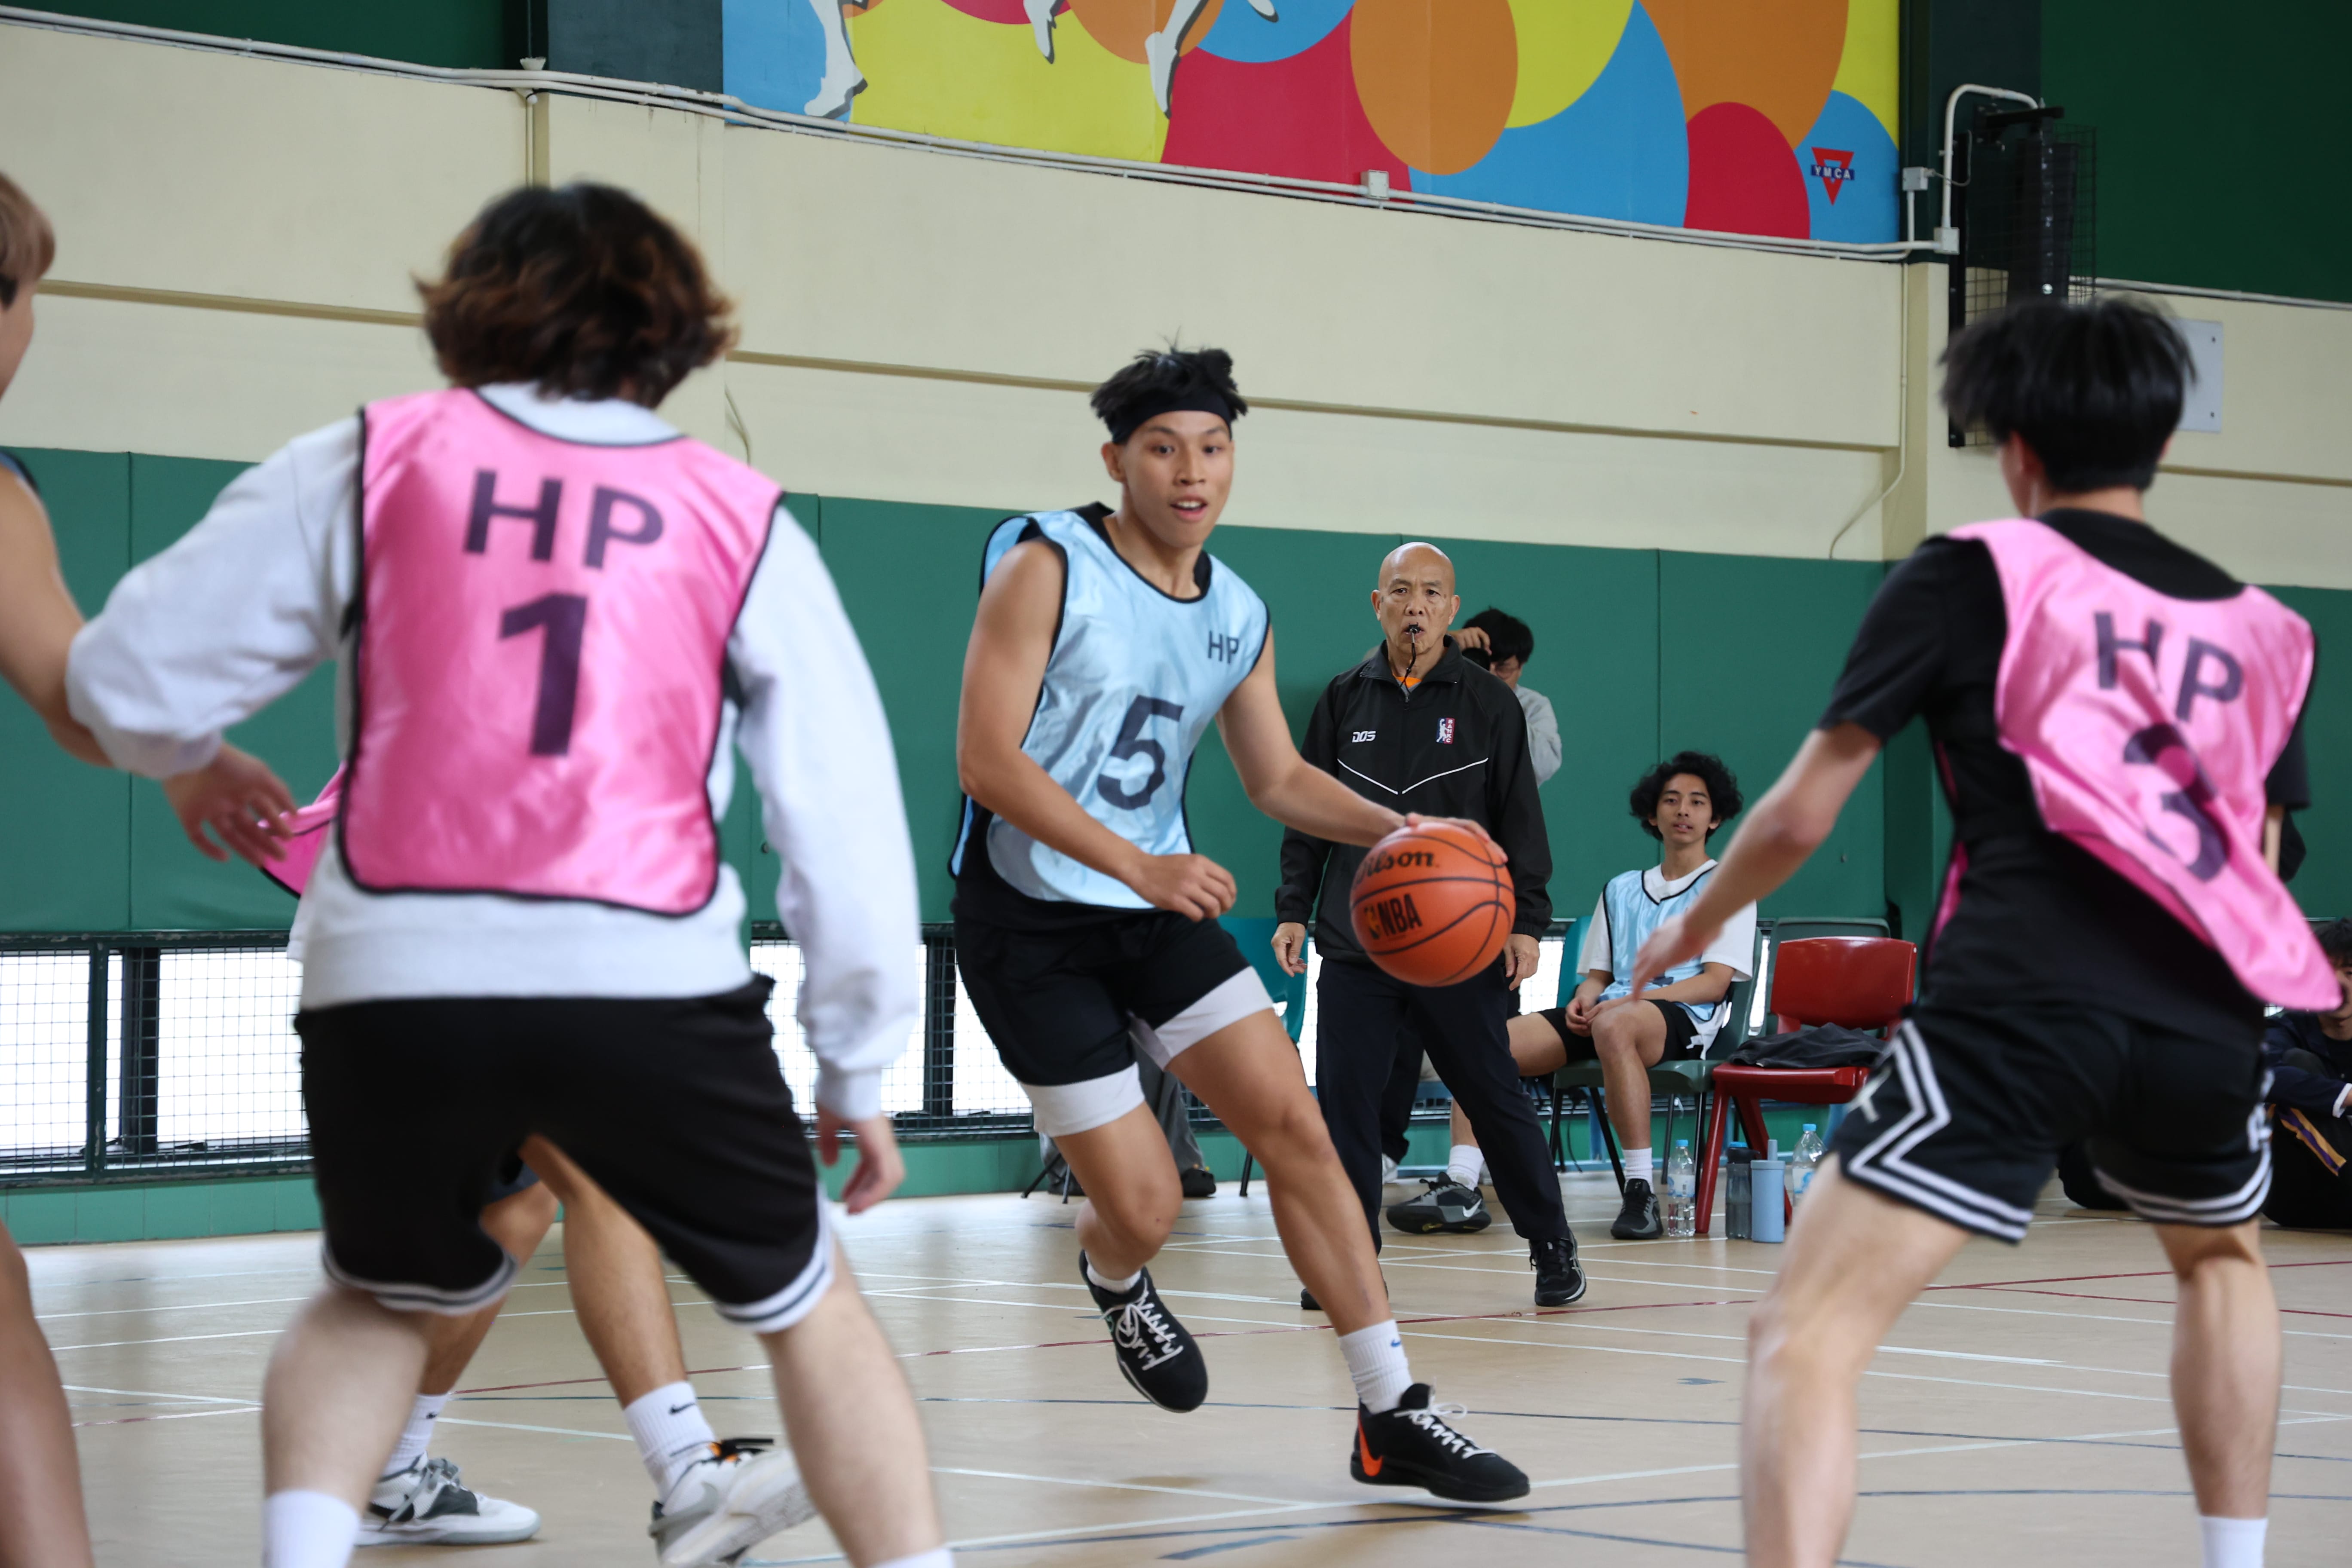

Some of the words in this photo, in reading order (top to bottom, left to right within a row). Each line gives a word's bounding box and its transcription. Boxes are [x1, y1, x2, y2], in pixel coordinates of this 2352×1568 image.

[1814, 165, 1851, 179] YMCA
[464, 469, 665, 570] HP
[499, 590, 588, 756] 1
[1208, 630, 1239, 664] HP
[2094, 612, 2244, 723] HP
[1096, 694, 1184, 811] 5
[1351, 731, 1376, 743] DOS
[2123, 722, 2232, 882] 3
[1377, 894, 1423, 937] NBA
